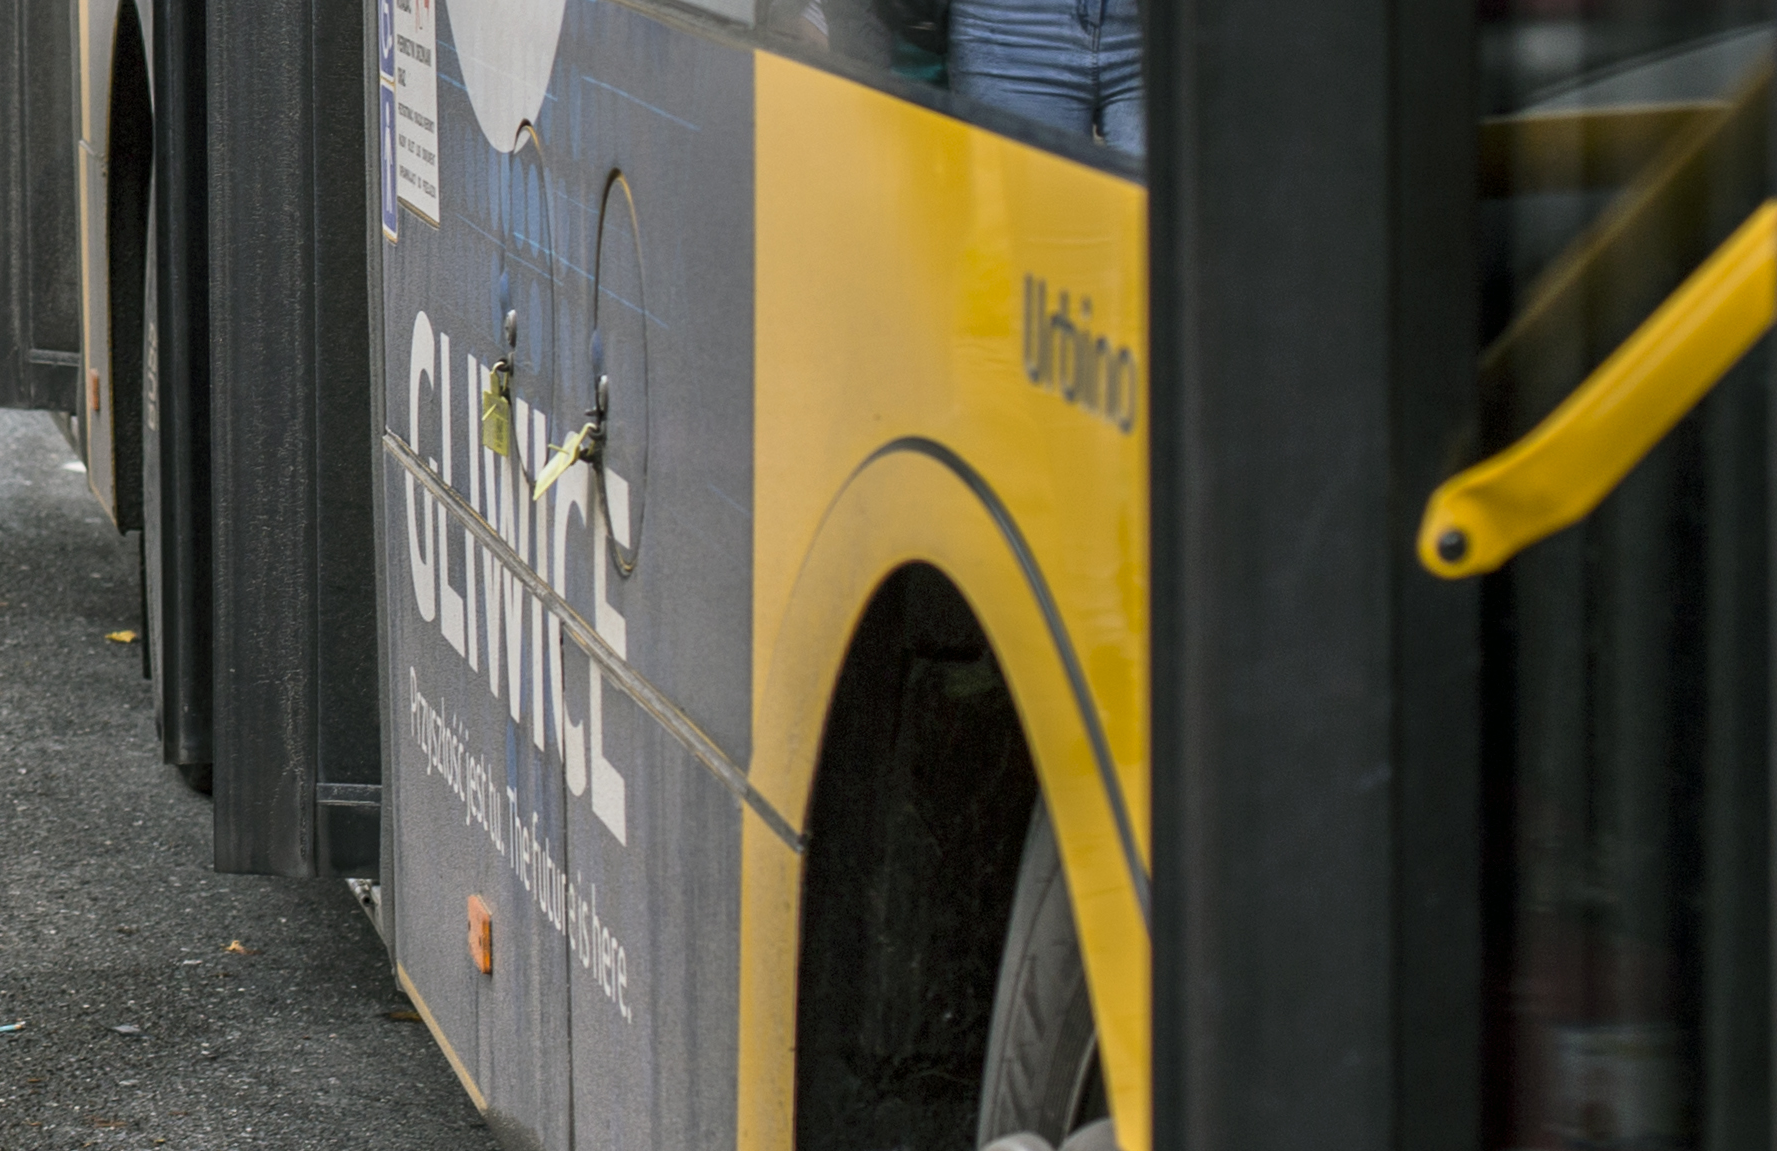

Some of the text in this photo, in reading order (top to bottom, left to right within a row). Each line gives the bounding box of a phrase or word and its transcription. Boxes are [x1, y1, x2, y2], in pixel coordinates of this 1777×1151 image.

[1024, 272, 1137, 435] Urbino
[405, 311, 630, 847] GLIWICE
[410, 665, 631, 1024] Przyszłość jest tu. The future is here.
